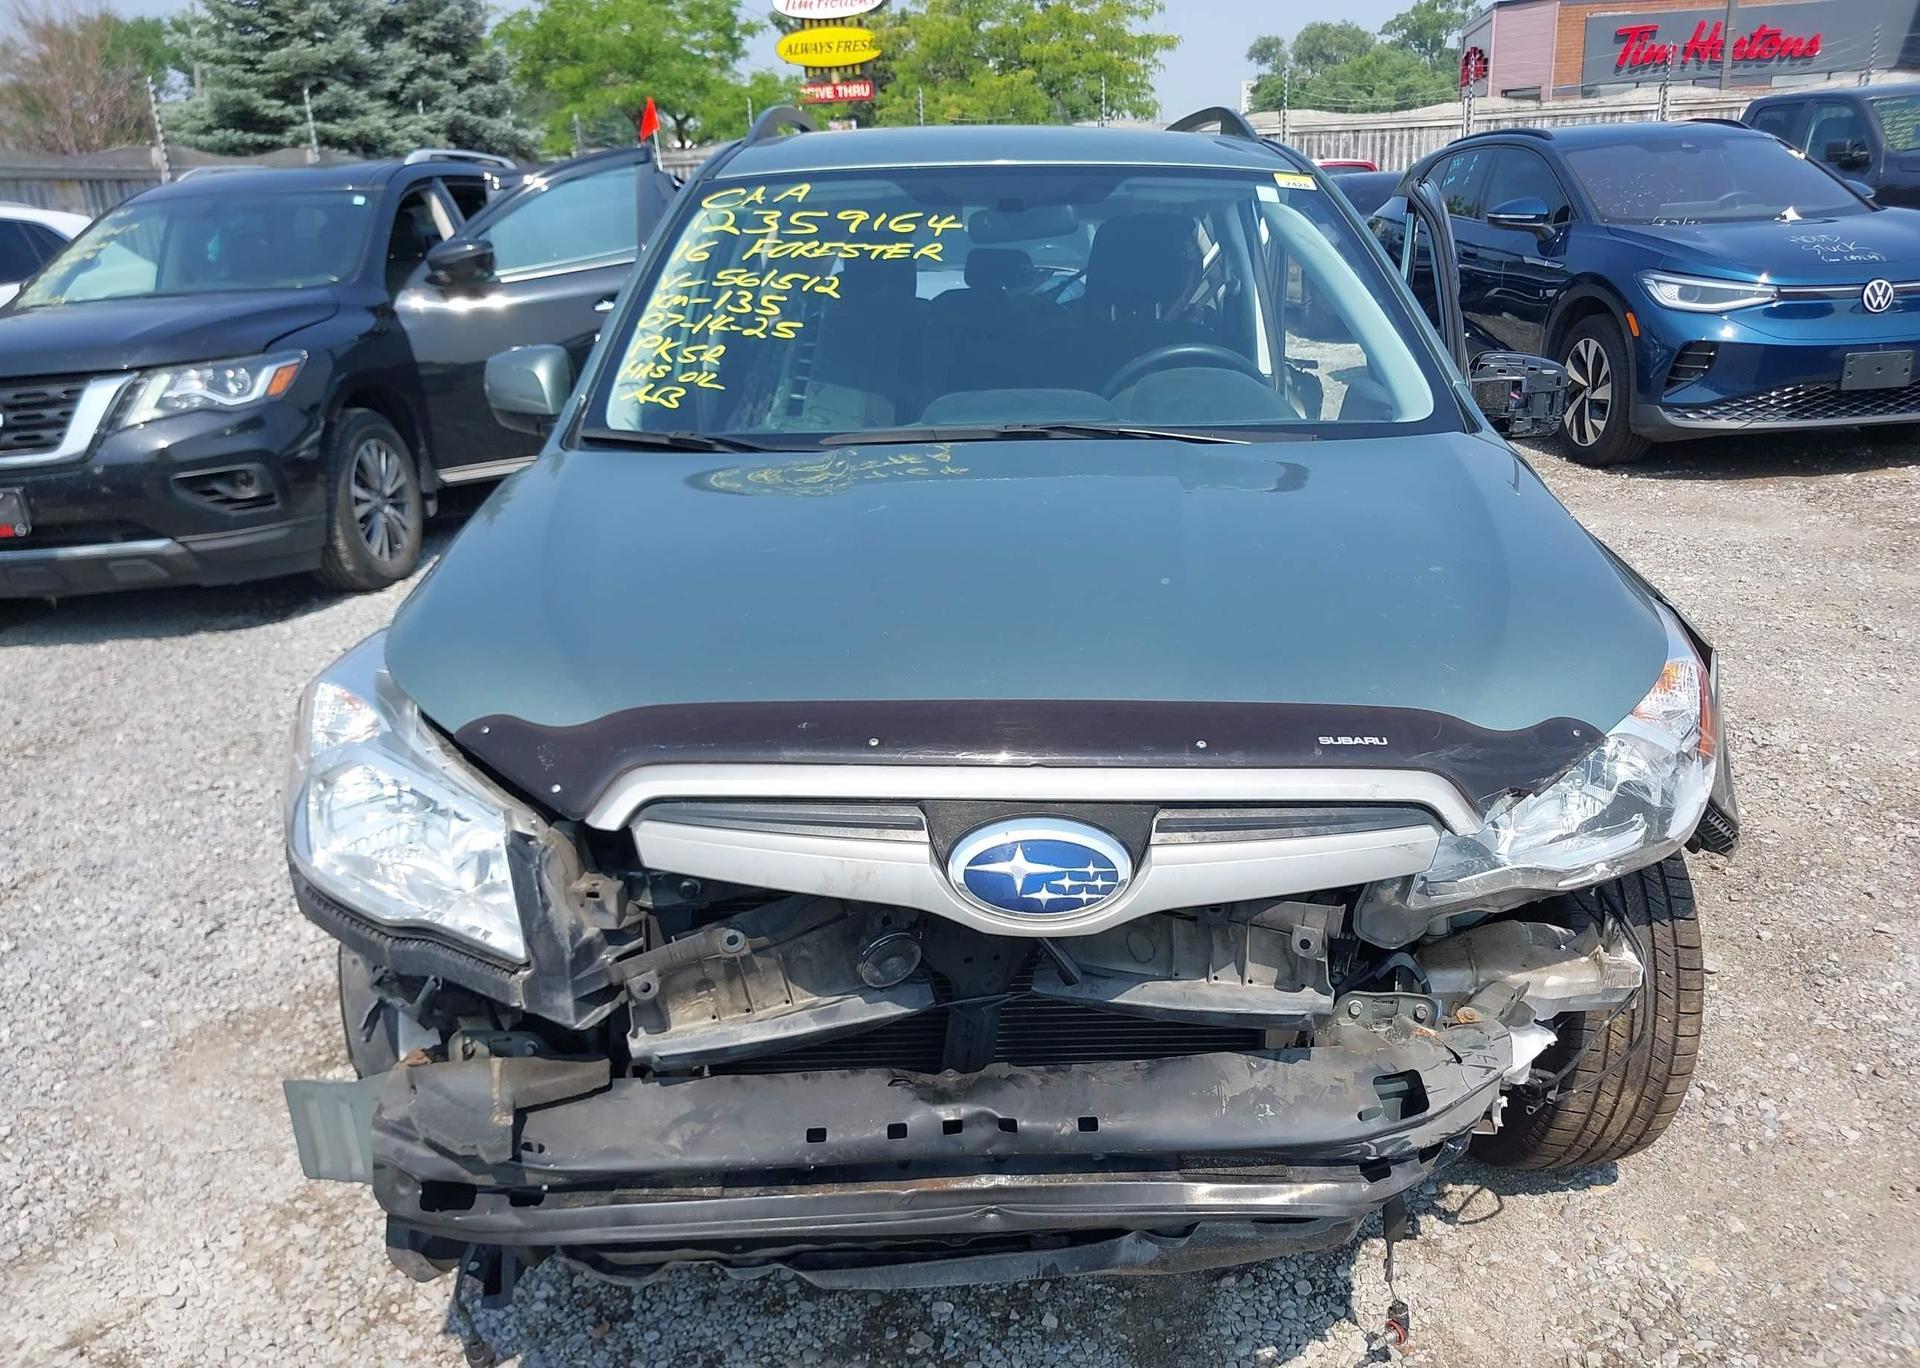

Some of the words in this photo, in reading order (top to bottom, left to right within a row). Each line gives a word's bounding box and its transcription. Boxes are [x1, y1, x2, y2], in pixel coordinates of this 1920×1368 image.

[784, 40, 833, 56] ALWAYS
[1616, 24, 1676, 67] Tim
[837, 83, 870, 98] THRU
[701, 183, 811, 209] CAA
[671, 240, 719, 262] 16
[742, 239, 944, 262] FORESTER
[1318, 736, 1388, 746] SUBARU
